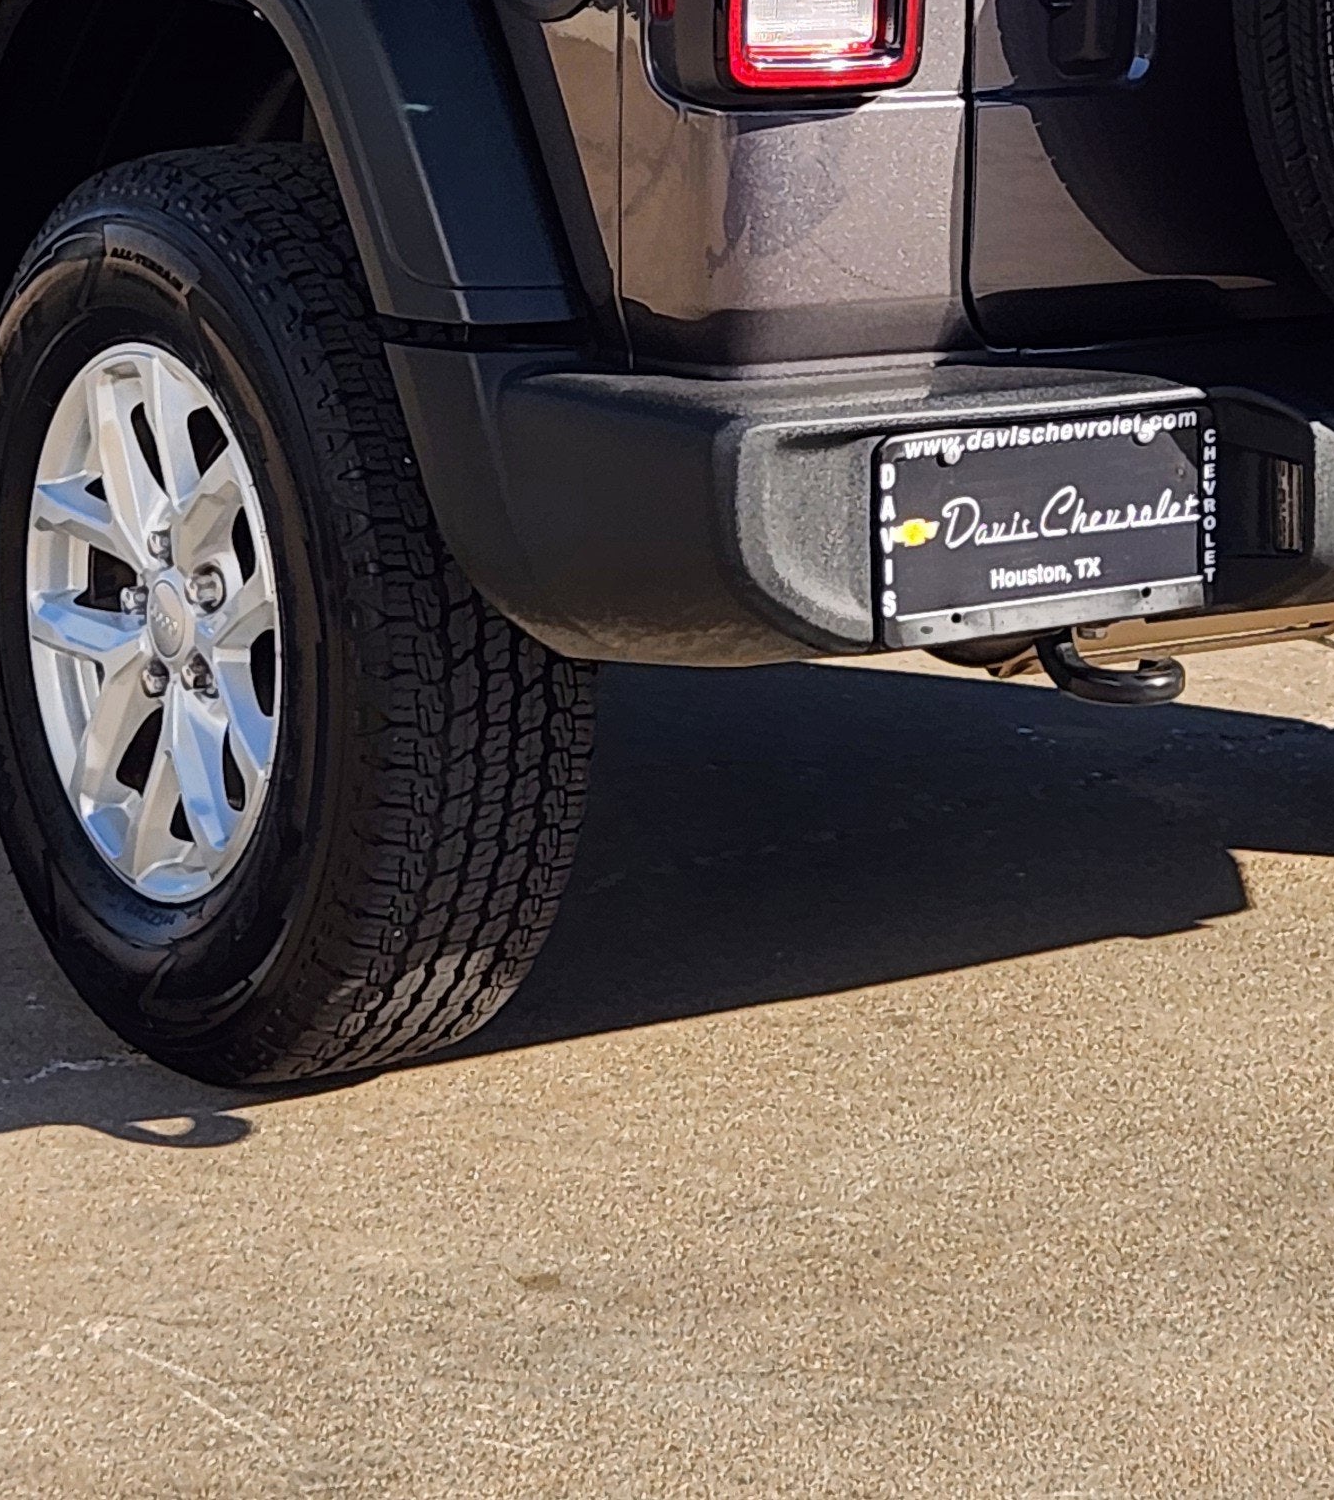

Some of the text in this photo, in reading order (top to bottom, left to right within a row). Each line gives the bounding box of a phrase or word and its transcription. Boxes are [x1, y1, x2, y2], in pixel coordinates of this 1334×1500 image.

[905, 412, 1197, 459] www.davischevrolet.com
[942, 485, 1202, 549] Davis Chevrolet
[1203, 428, 1217, 583] CHEVROLET
[879, 462, 897, 618] DAVIS
[990, 556, 1101, 591] Houston, TX
